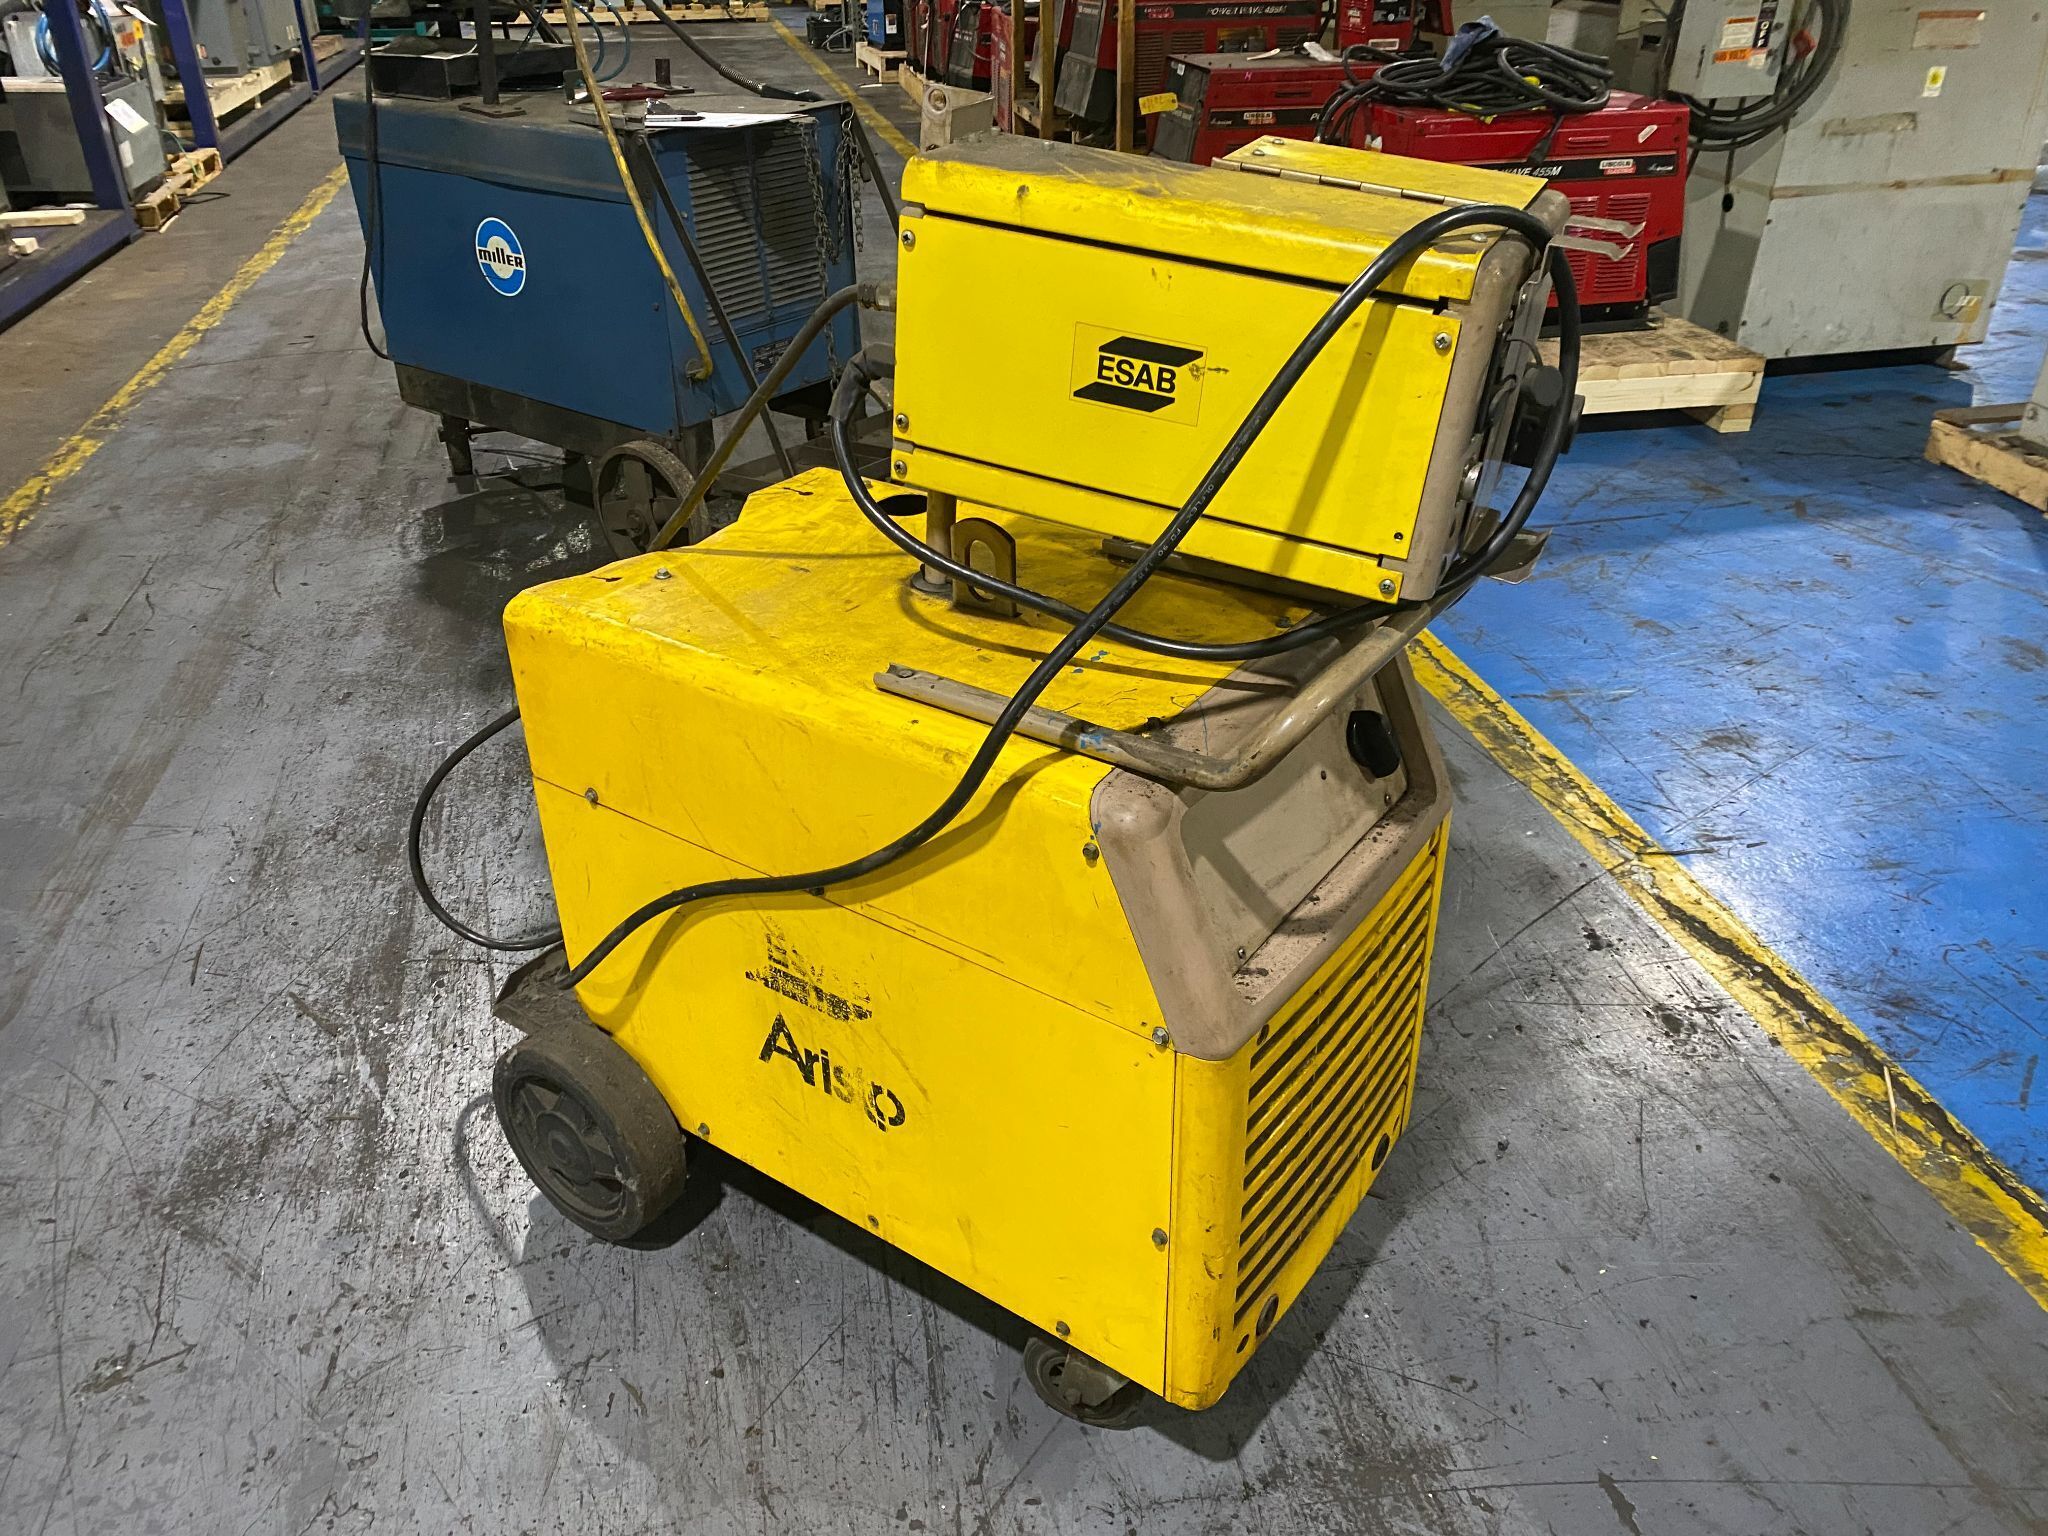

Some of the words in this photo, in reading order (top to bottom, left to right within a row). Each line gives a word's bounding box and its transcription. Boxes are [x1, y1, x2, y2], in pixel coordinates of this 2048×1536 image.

[1532, 165, 1564, 177] 455M
[1601, 160, 1632, 168] LINCOLN
[1097, 354, 1177, 394] ESAB
[758, 1011, 906, 1133] Ariso
